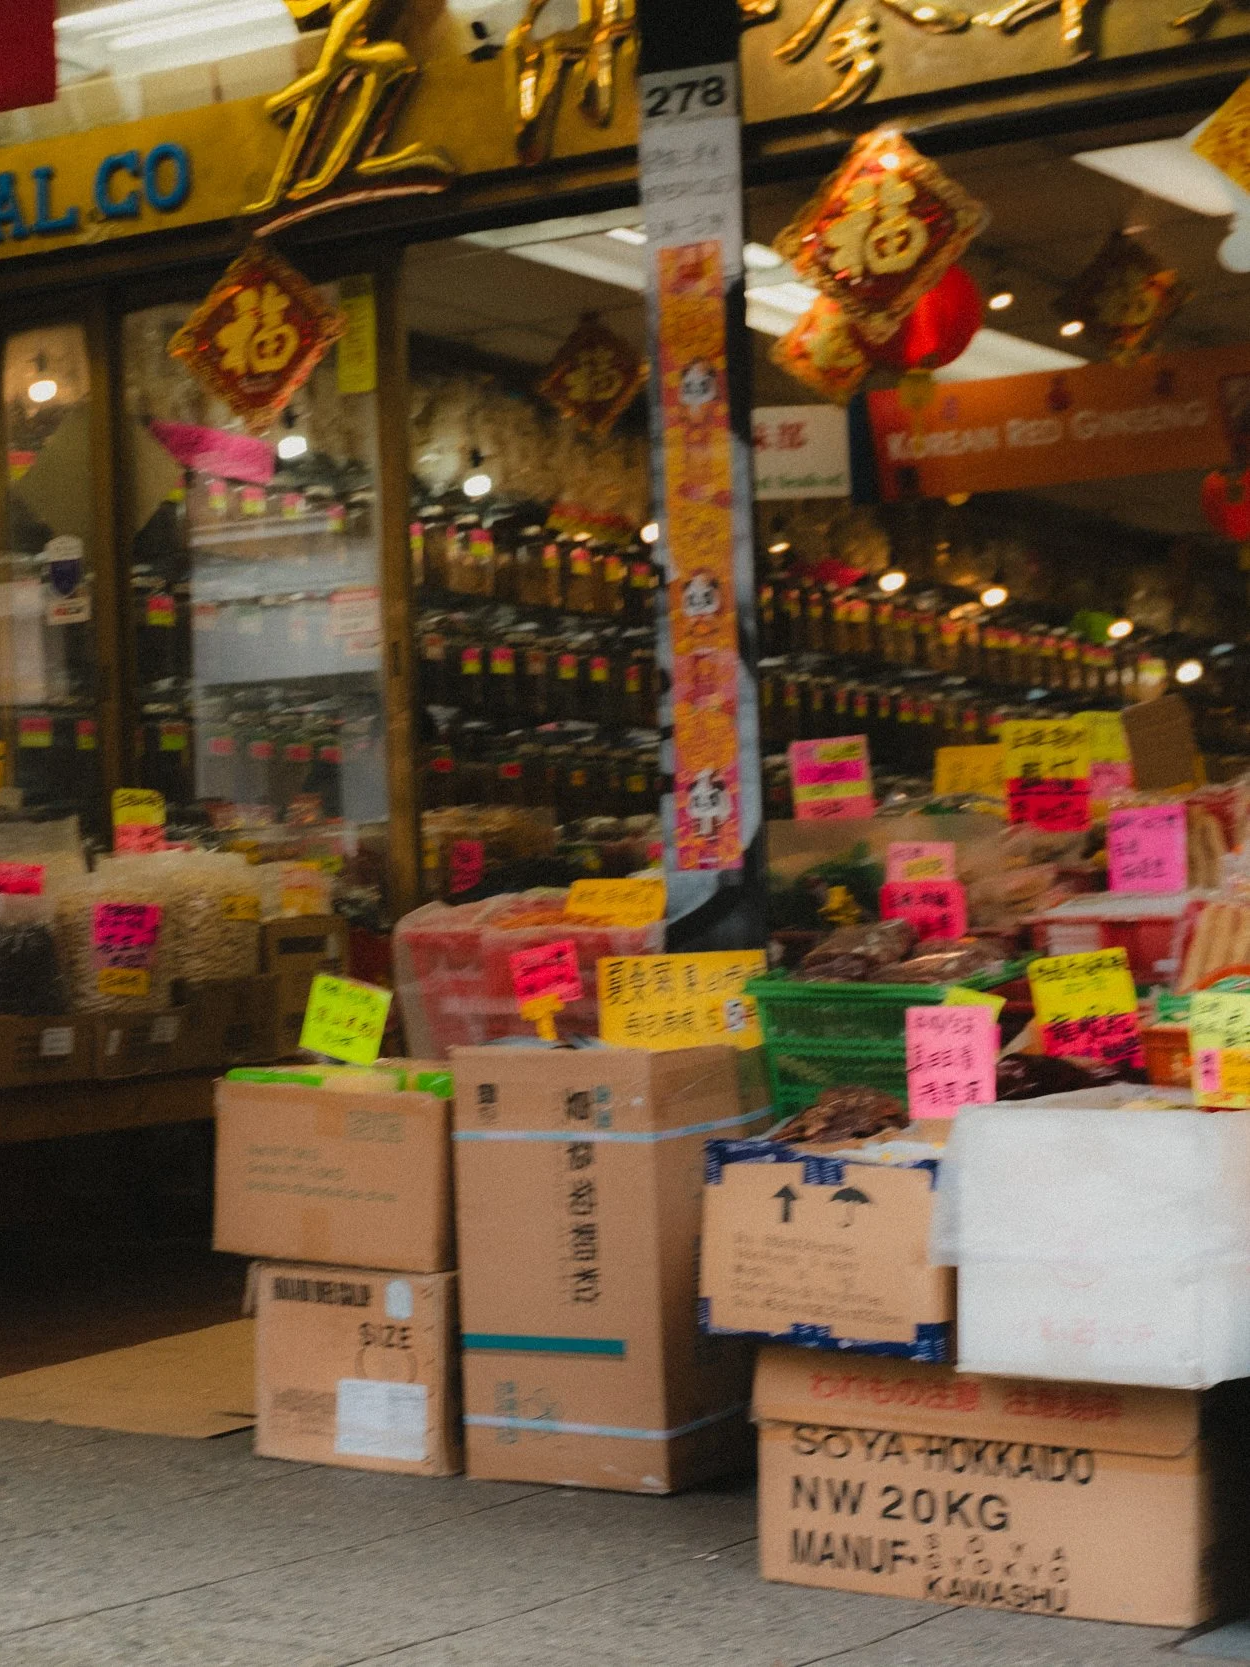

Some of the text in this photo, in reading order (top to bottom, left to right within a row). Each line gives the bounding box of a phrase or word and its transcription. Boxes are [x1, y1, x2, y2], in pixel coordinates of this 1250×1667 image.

[645, 75, 726, 118] 278
[94, 142, 193, 219] CO
[216, 282, 299, 376] 福
[886, 424, 1001, 461] KOREAN
[1006, 417, 1064, 447] RED
[359, 1321, 412, 1350] SIZE
[791, 1475, 1011, 1532] NW 20KG
